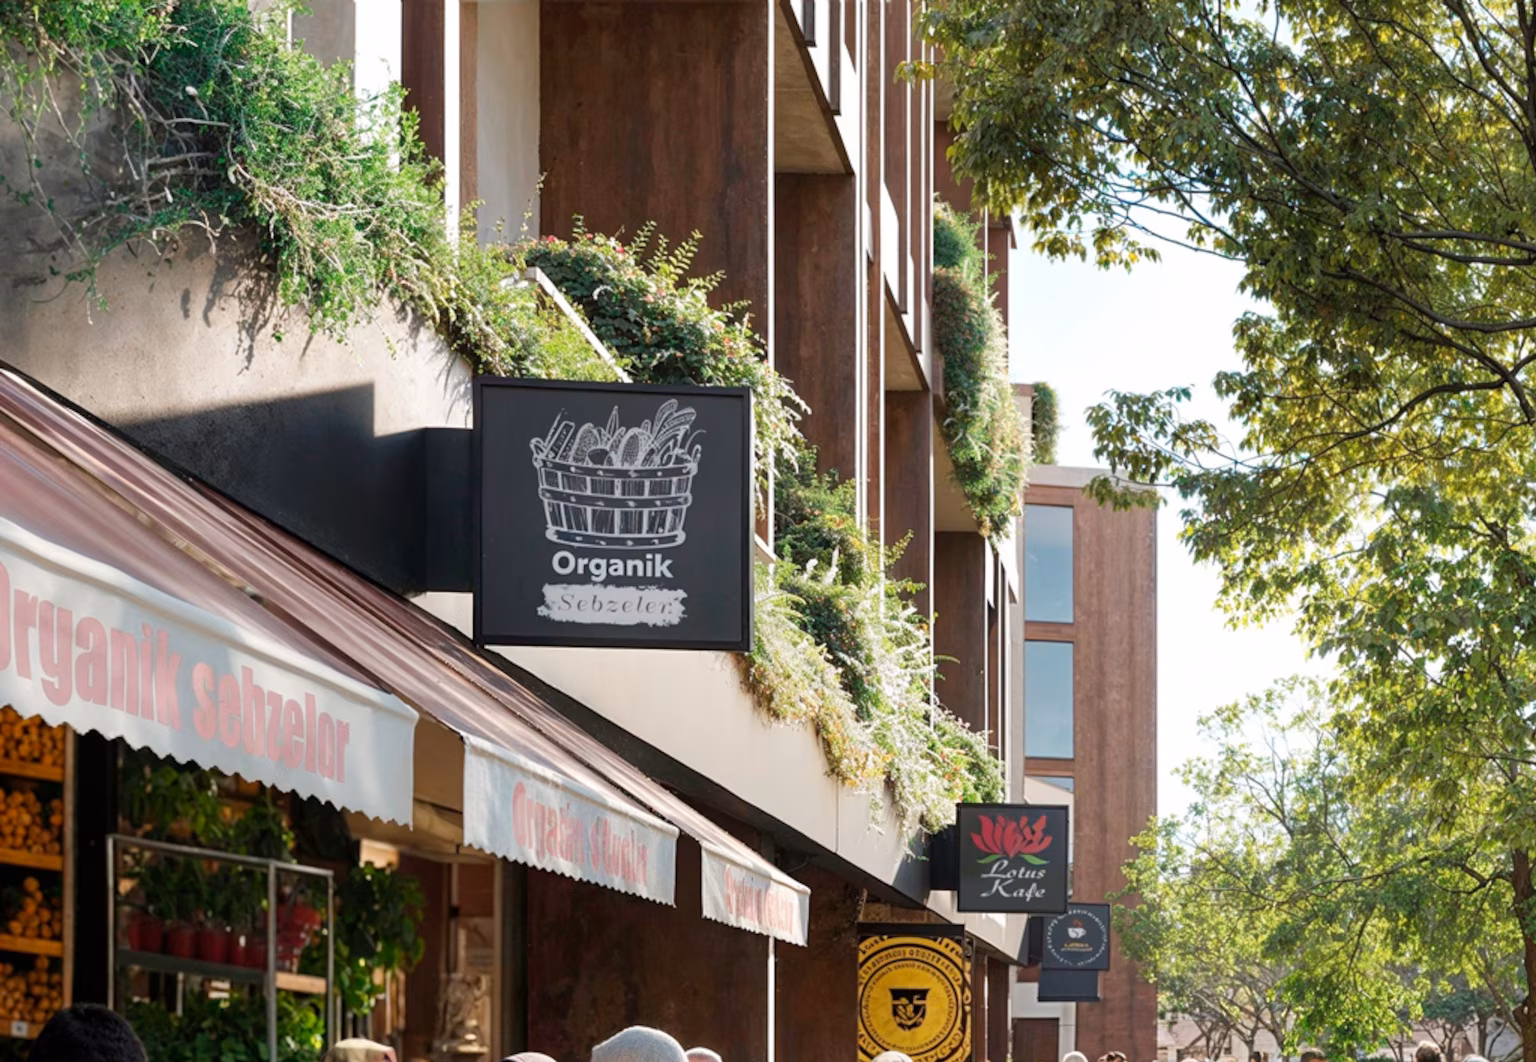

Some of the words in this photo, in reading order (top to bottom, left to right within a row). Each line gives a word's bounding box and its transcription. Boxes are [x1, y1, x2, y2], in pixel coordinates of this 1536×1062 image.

[552, 550, 674, 582] Organik
[557, 593, 673, 615] Sebzeler
[980, 859, 1047, 879] Lotus
[980, 879, 1046, 902] Kafe
